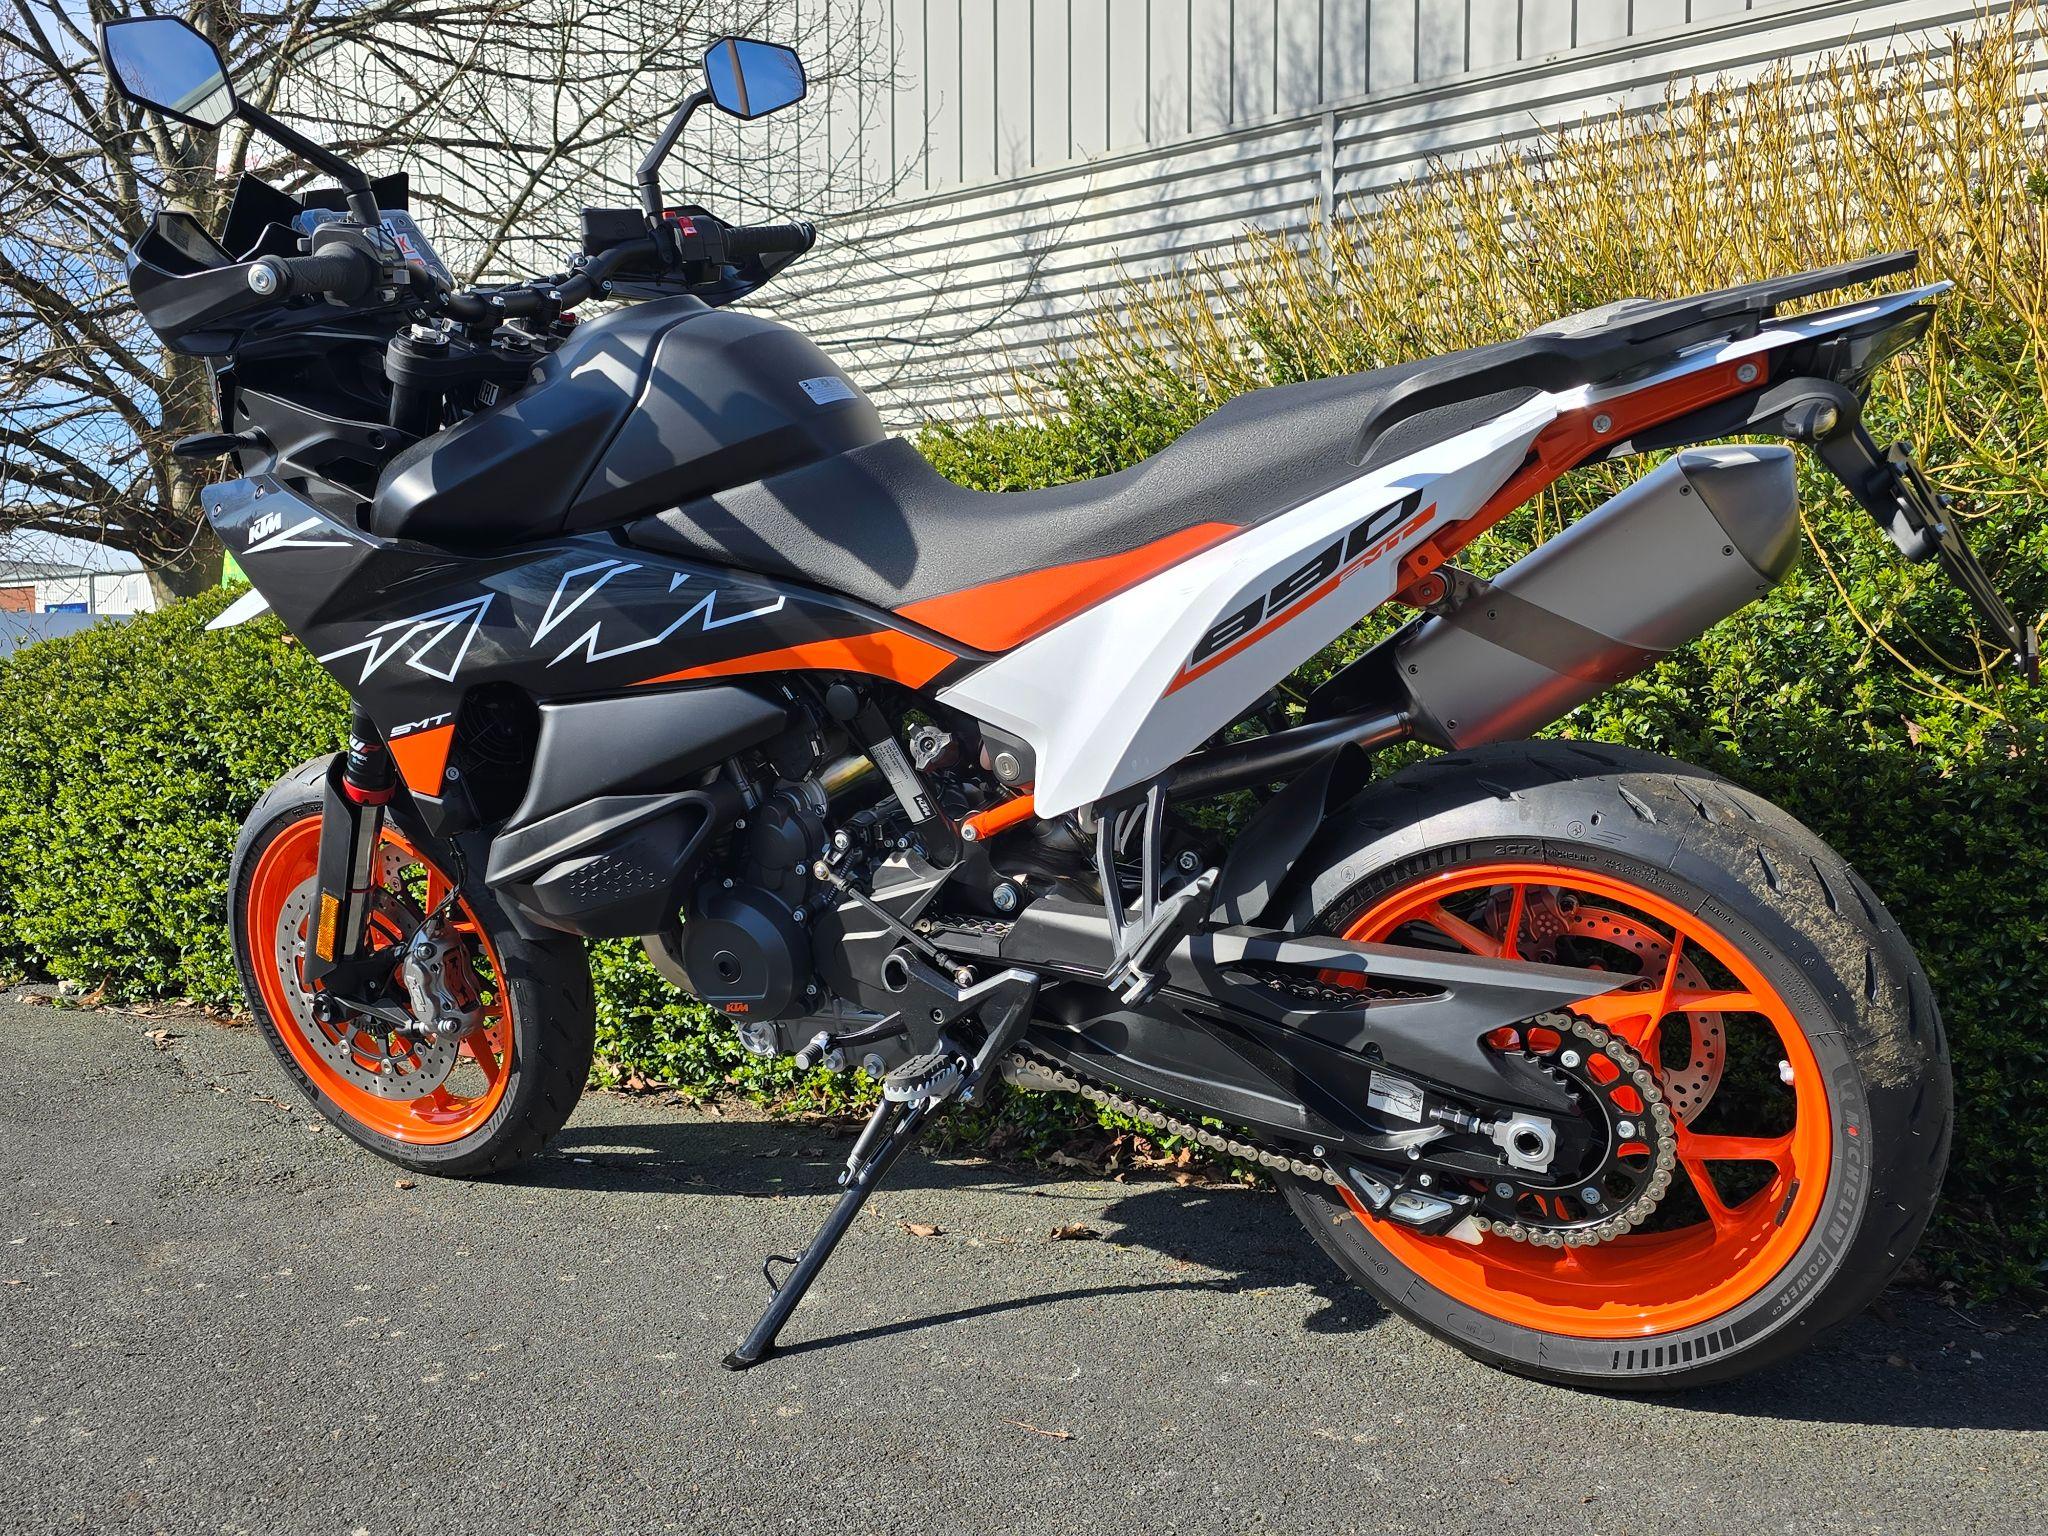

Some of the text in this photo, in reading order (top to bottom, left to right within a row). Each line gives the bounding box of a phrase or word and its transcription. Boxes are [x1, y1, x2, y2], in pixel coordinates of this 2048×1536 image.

[248, 511, 282, 545] KTM
[1339, 522, 1415, 583] SMT
[1190, 487, 1424, 667] 890
[390, 712, 452, 738] SMT
[916, 796, 932, 817] KTM
[1546, 847, 1590, 864] MICHELIN
[726, 1002, 749, 1012] KTM
[1828, 1108, 1861, 1245] MICHELIN
[1779, 1252, 1828, 1307] POWER
